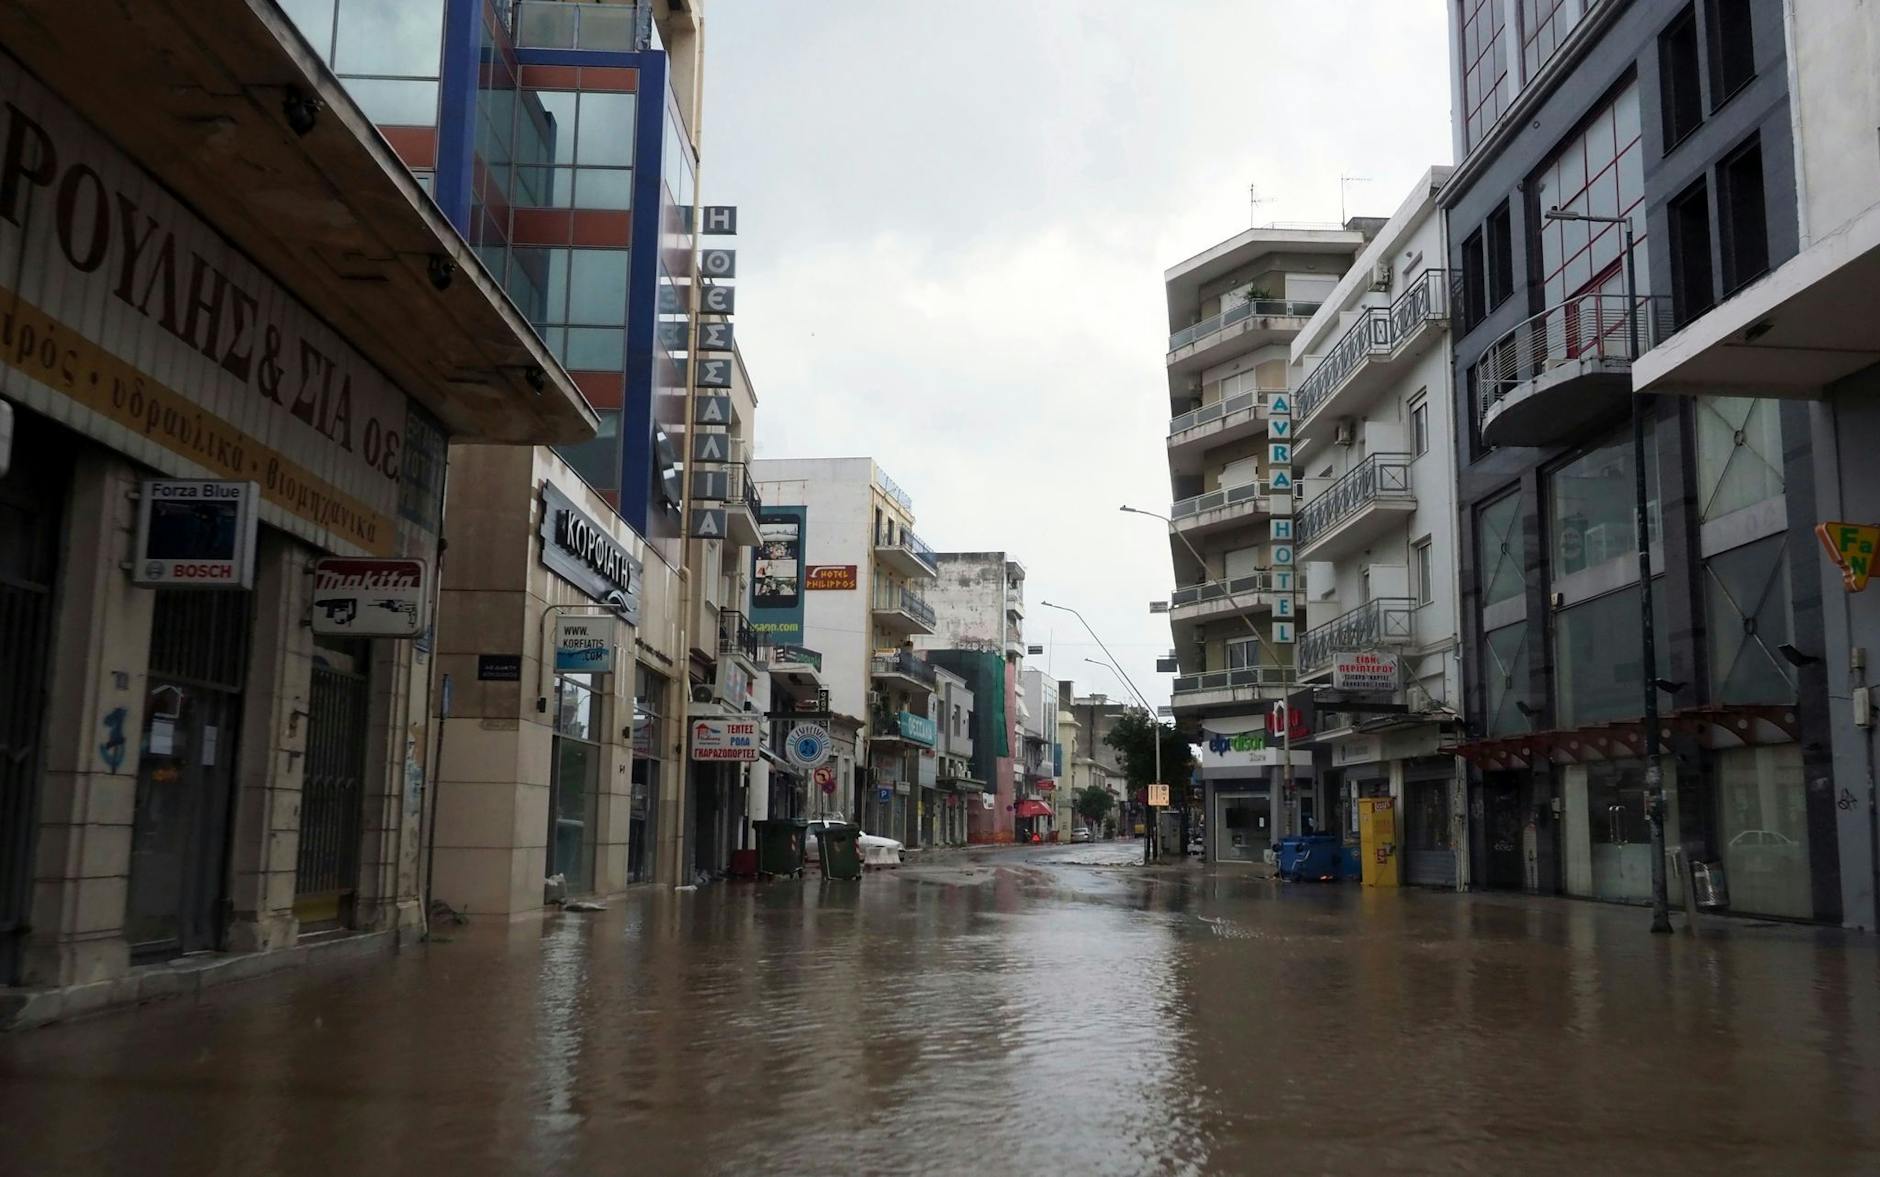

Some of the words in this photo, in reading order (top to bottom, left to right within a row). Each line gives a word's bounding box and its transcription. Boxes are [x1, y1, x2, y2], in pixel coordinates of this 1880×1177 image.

[1273, 396, 1290, 486] AVRA
[151, 482, 197, 498] Forza
[203, 482, 240, 498] Blue
[173, 563, 232, 579] BOSCH
[820, 570, 849, 579] HOTEL
[806, 580, 855, 589] PHILIPPOS
[1275, 522, 1291, 641] HOTEL
[563, 639, 604, 648] KORFIATIS
[727, 724, 754, 734] ΤΕΝΤΕΣ
[694, 748, 756, 758] ΓΚΑΡΑΖΟΠΟΡΤΕΣ
